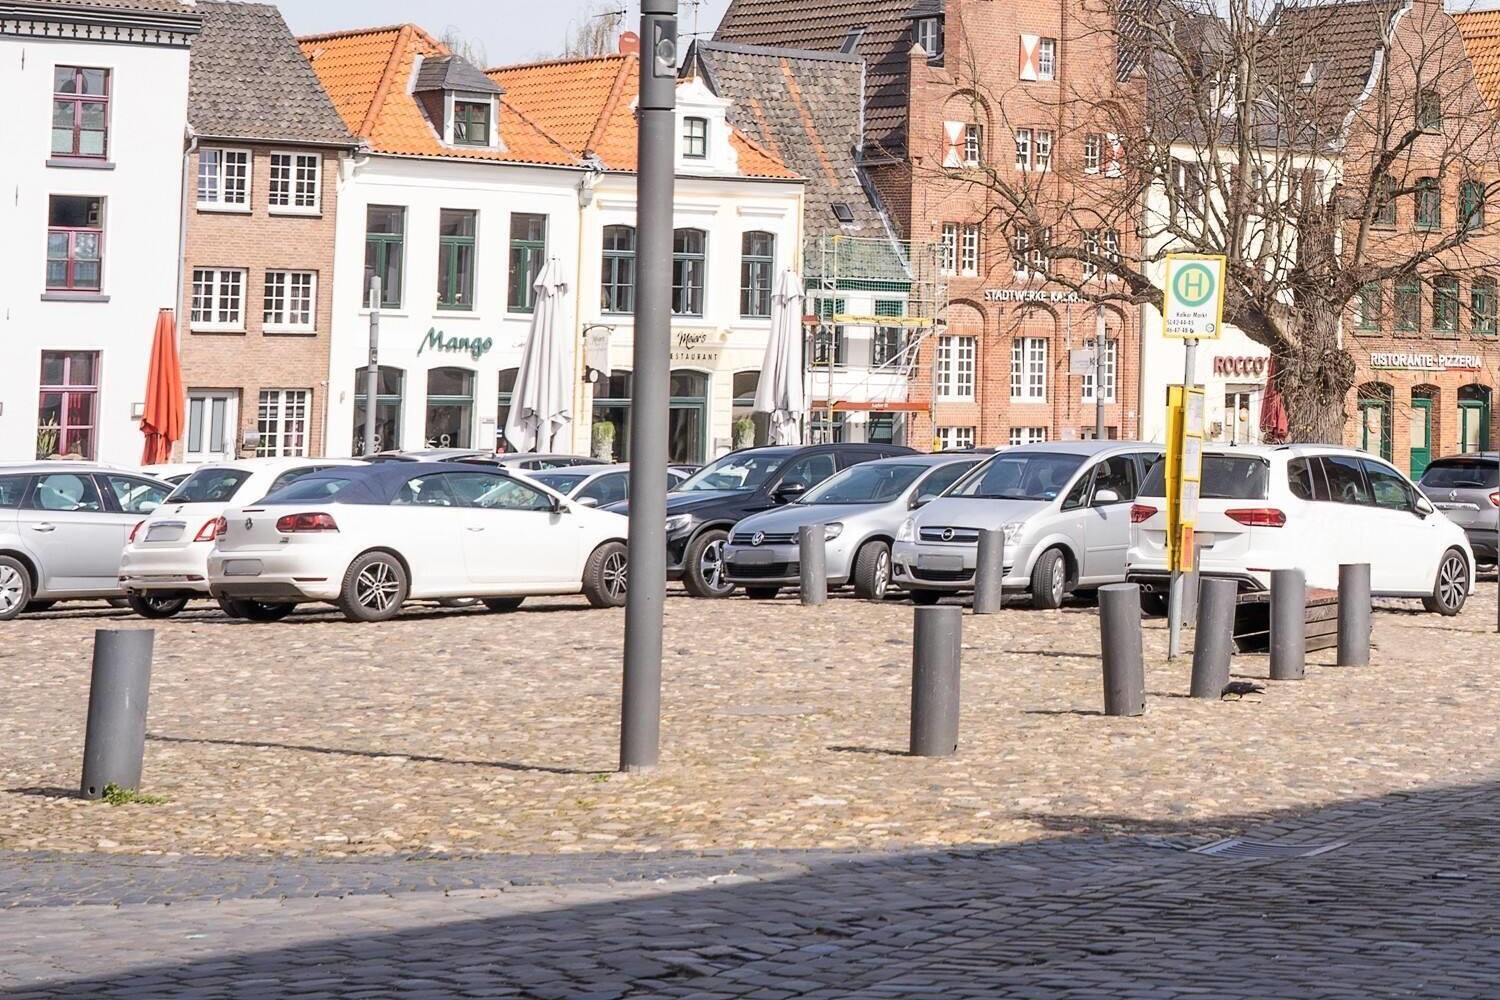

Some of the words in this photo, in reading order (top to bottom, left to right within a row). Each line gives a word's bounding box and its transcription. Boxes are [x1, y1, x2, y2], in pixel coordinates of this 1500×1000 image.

[984, 289, 1047, 303] STADTWERKE
[1185, 273, 1203, 297] H
[416, 327, 493, 361] Mango
